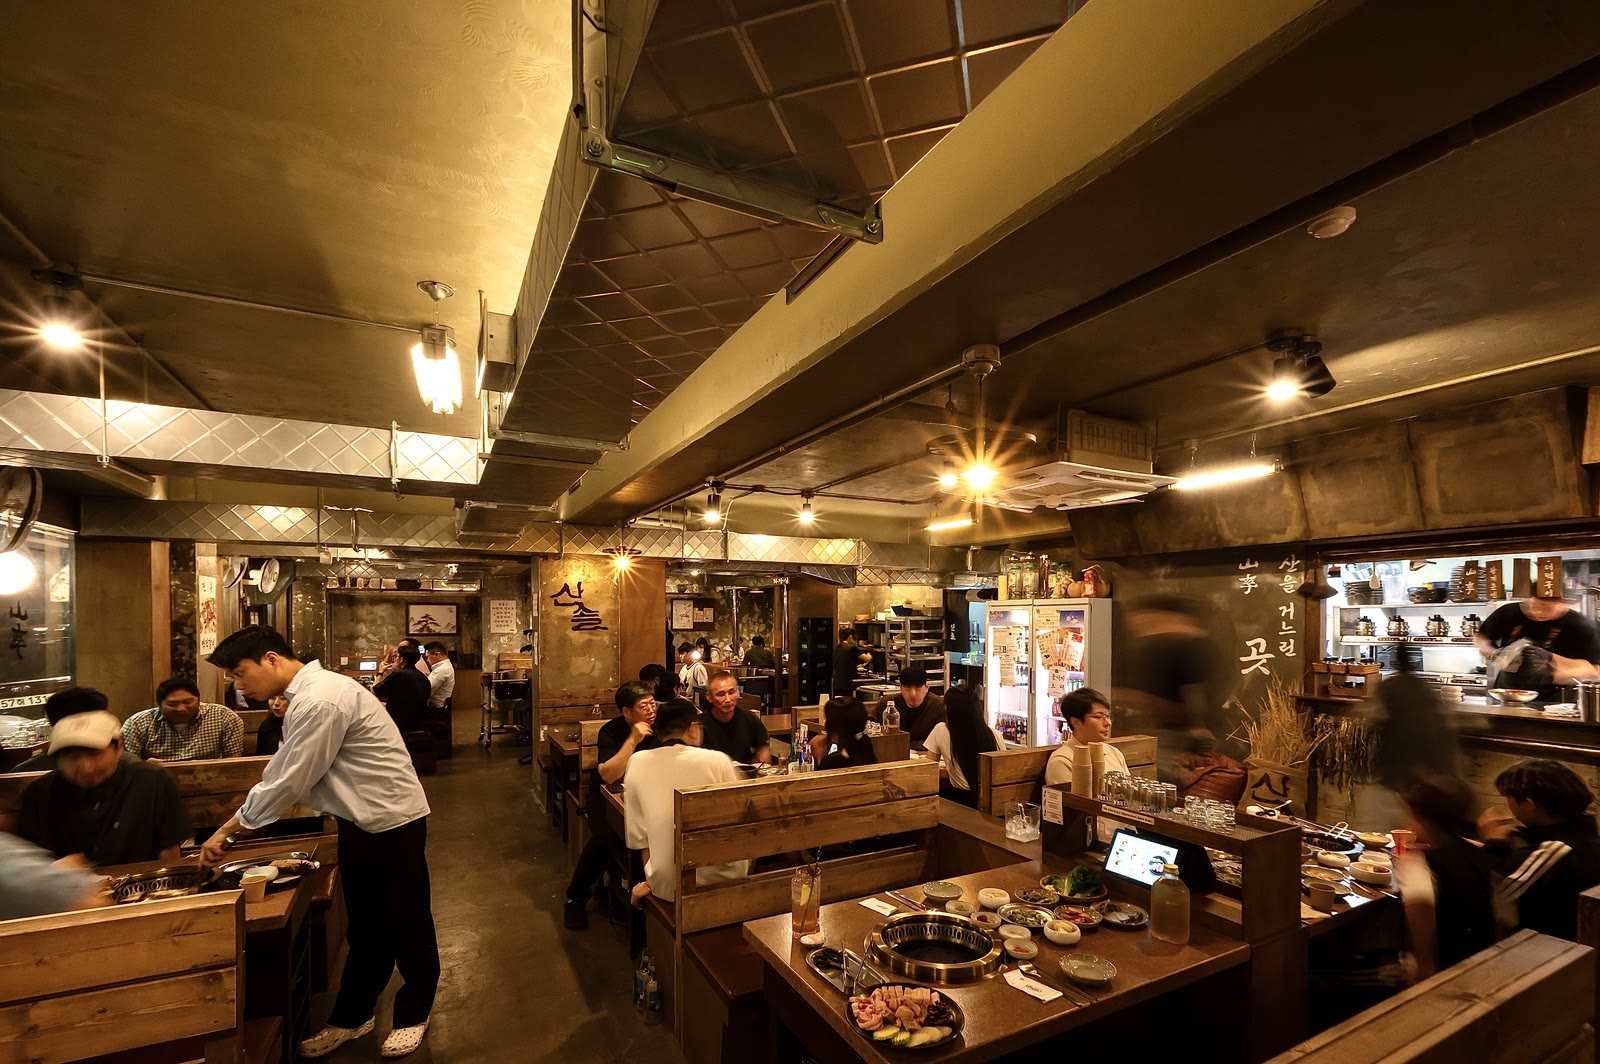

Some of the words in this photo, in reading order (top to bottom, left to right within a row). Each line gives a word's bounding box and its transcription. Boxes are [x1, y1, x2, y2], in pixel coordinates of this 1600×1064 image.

[1278, 553, 1300, 594] 산을
[1278, 601, 1297, 657] 거느린
[1239, 637, 1275, 676] 곳
